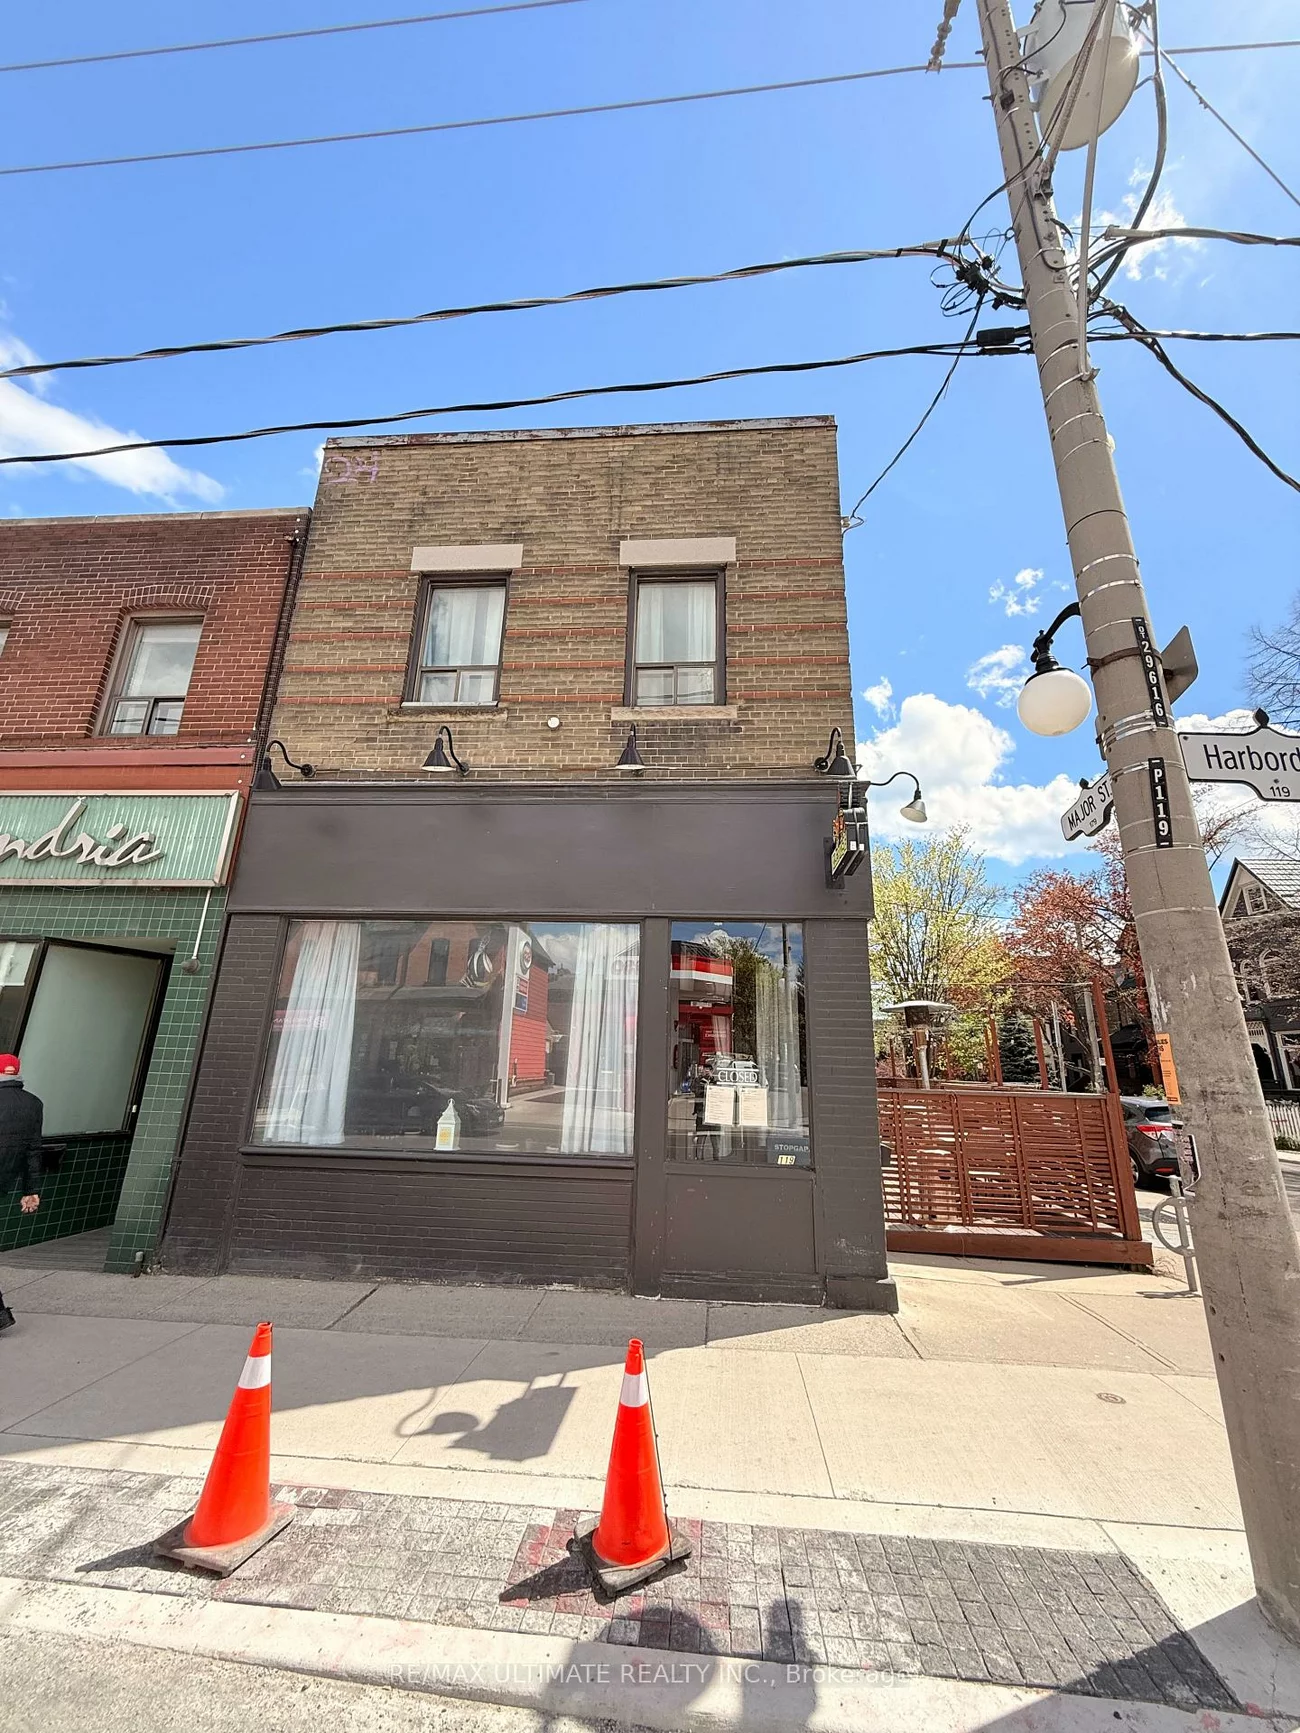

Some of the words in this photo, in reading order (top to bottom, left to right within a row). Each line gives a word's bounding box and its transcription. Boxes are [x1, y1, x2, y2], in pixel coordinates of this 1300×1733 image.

[1269, 785, 1291, 798] 119
[1153, 768, 1169, 836] P119
[1067, 795, 1097, 831] MAJOR
[718, 1070, 758, 1082] CLOSED
[777, 1154, 796, 1166] 119
